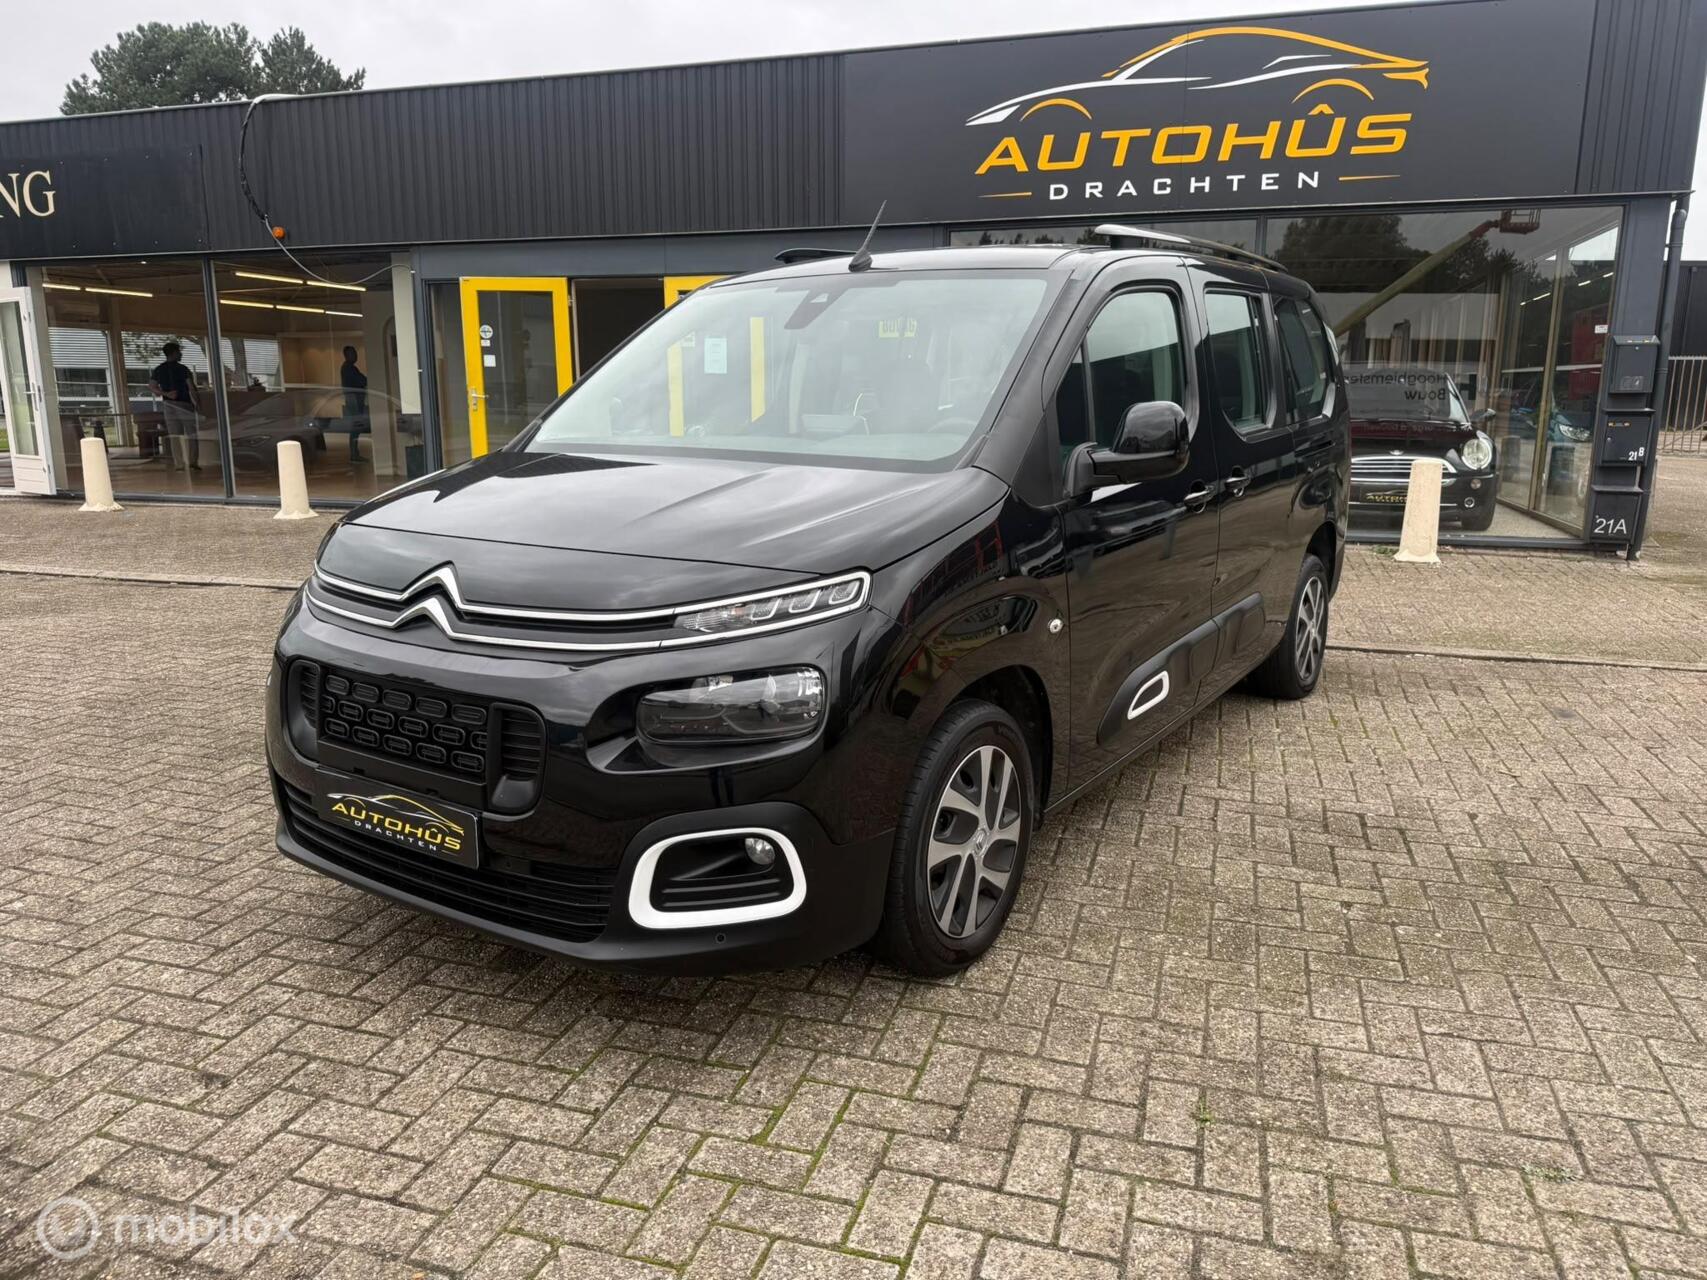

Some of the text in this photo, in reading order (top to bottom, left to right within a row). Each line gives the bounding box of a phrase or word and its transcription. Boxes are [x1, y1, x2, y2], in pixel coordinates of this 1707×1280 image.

[975, 103, 1413, 176] AUTOHÛS
[1049, 171, 1320, 201] DRACHTEN
[1593, 518, 1627, 534] 21A
[331, 802, 462, 851] AUTOHÛS
[353, 821, 438, 852] DRACHTEN
